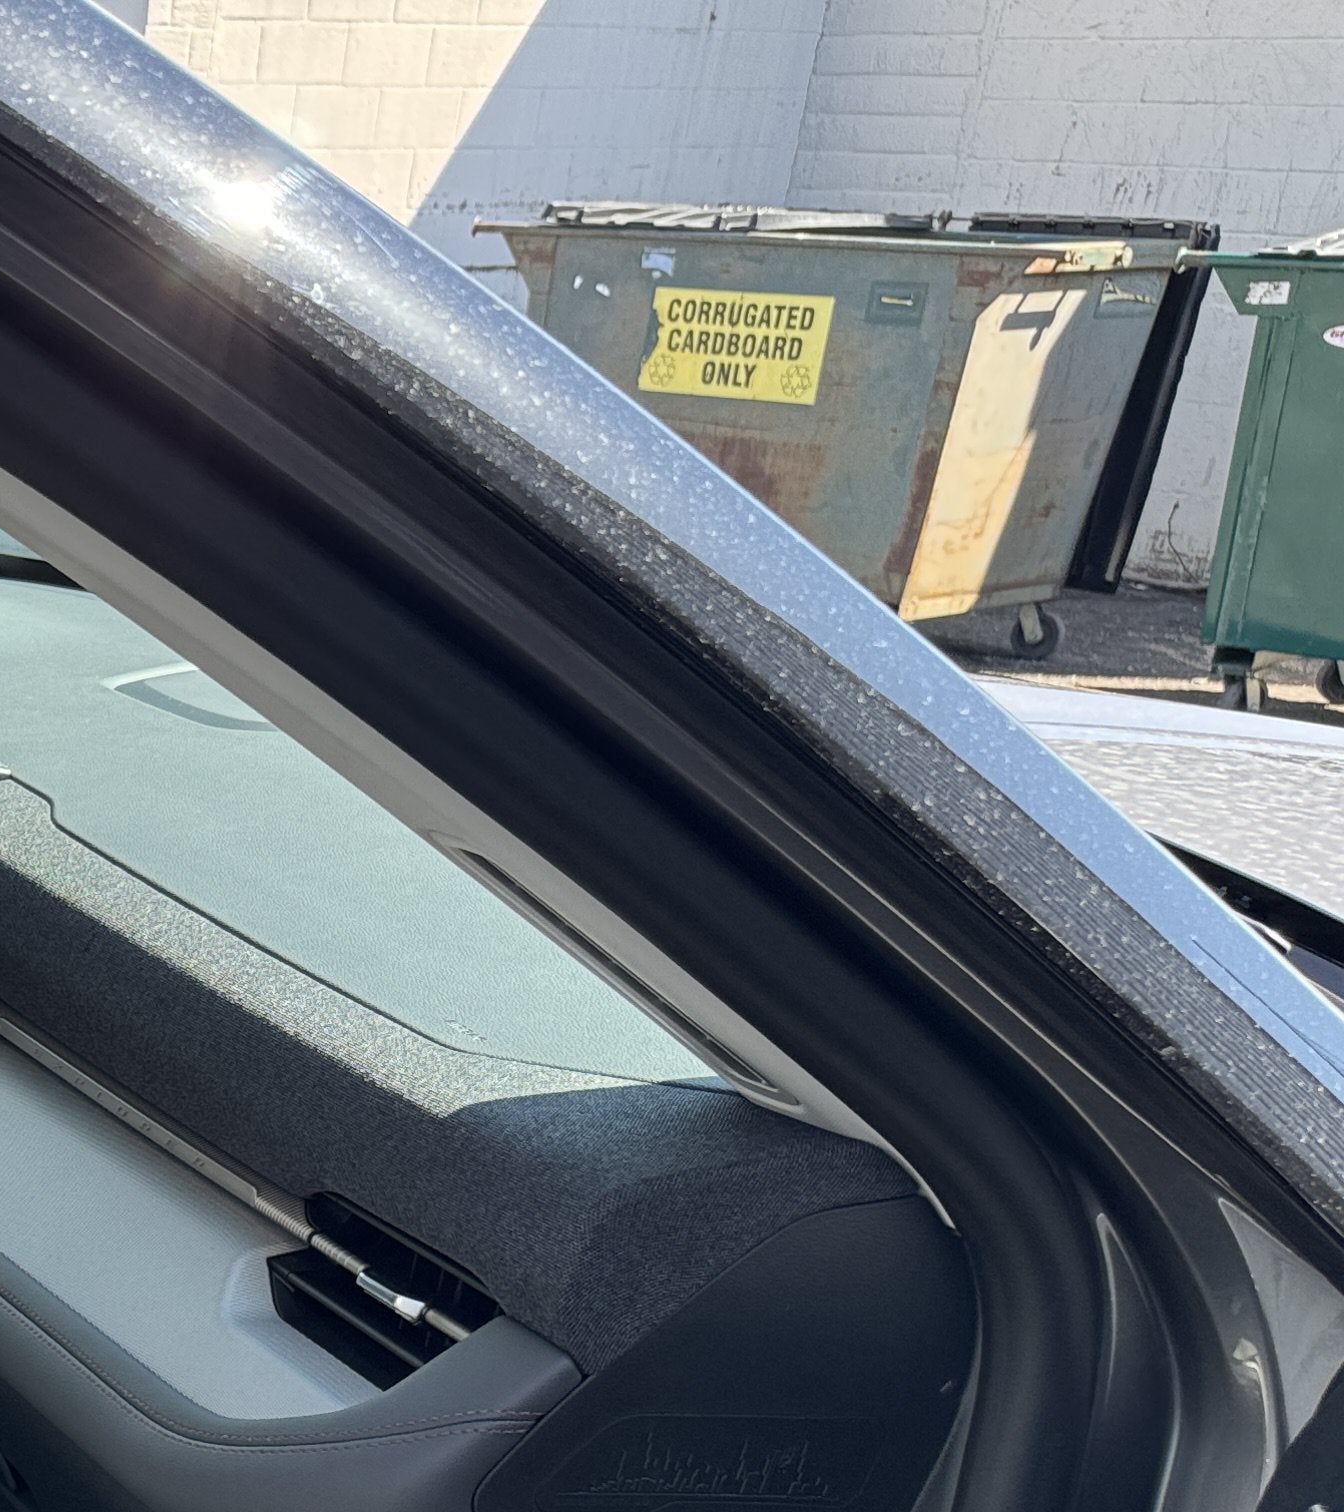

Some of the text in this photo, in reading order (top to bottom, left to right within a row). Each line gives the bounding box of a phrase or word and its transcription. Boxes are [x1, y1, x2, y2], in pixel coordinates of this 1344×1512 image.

[667, 299, 815, 331] CORRUGATED
[667, 329, 803, 361] CARDBOARD
[701, 361, 757, 389] ONLY
